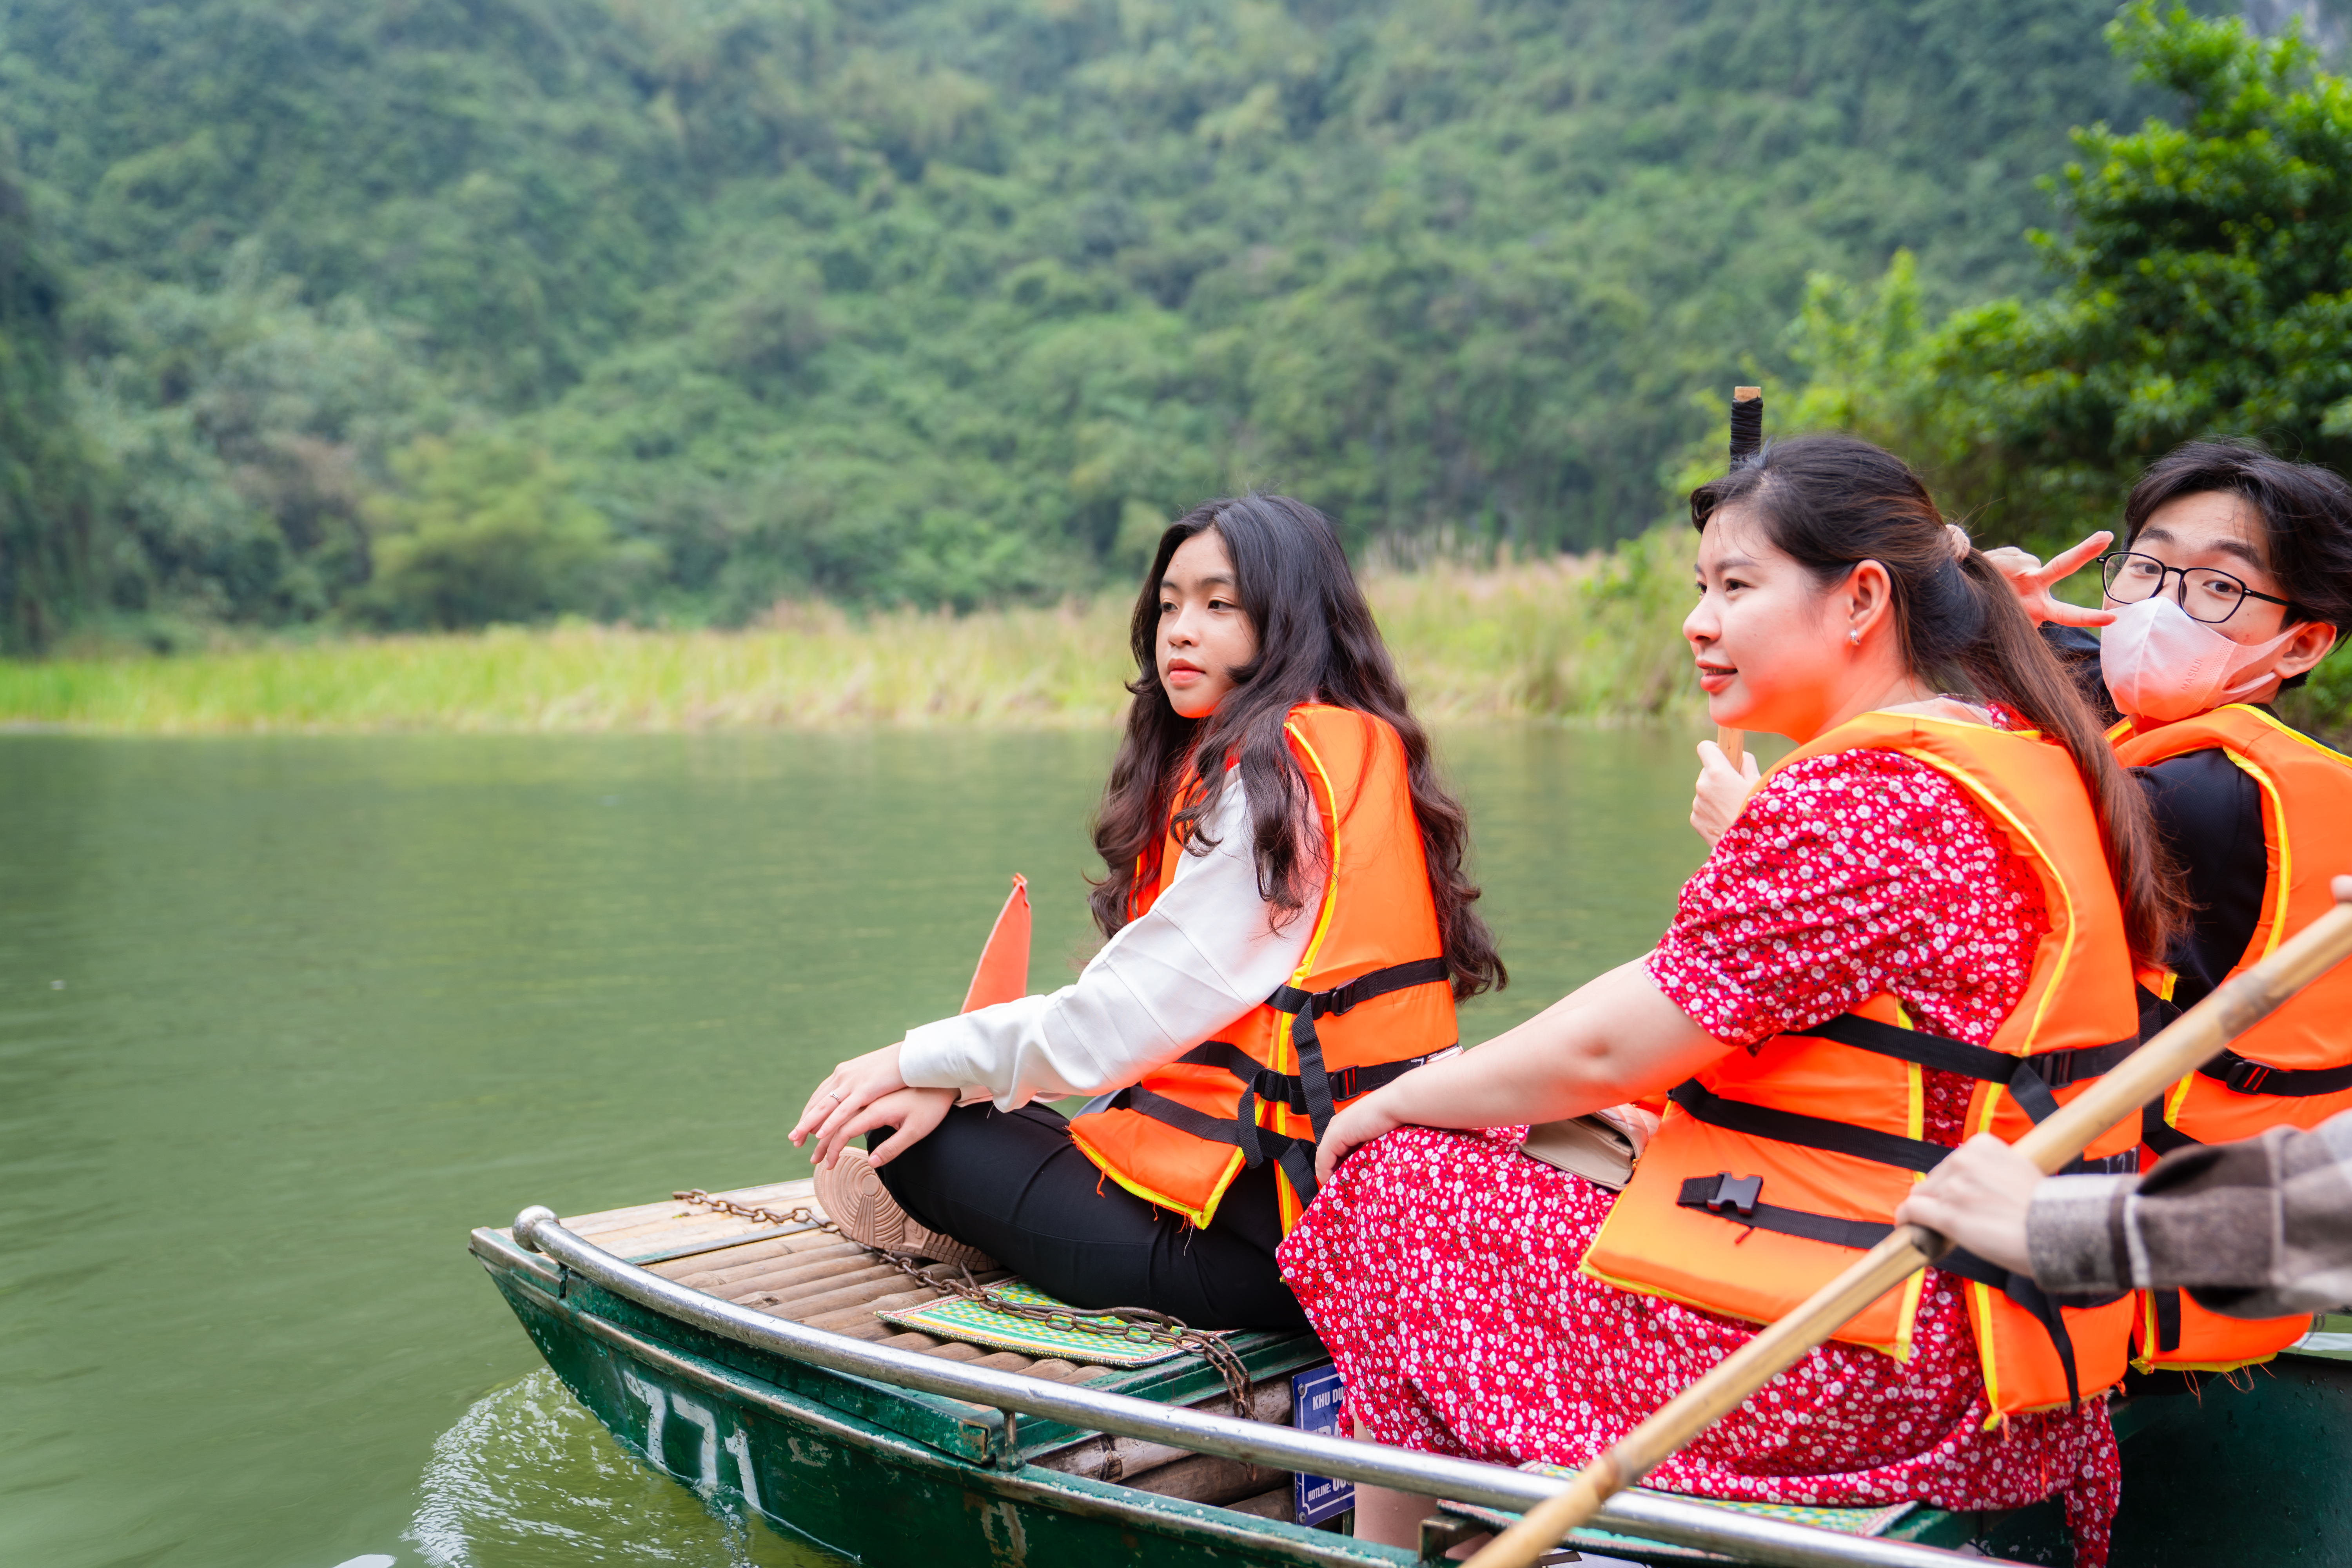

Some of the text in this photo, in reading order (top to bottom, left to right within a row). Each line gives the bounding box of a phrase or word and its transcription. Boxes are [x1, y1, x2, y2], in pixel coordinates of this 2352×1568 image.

[2180, 659, 2203, 691] MASUJI
[1312, 1386, 1344, 1411] KHU DU
[1308, 1483, 1331, 1502] HOTLINE:
